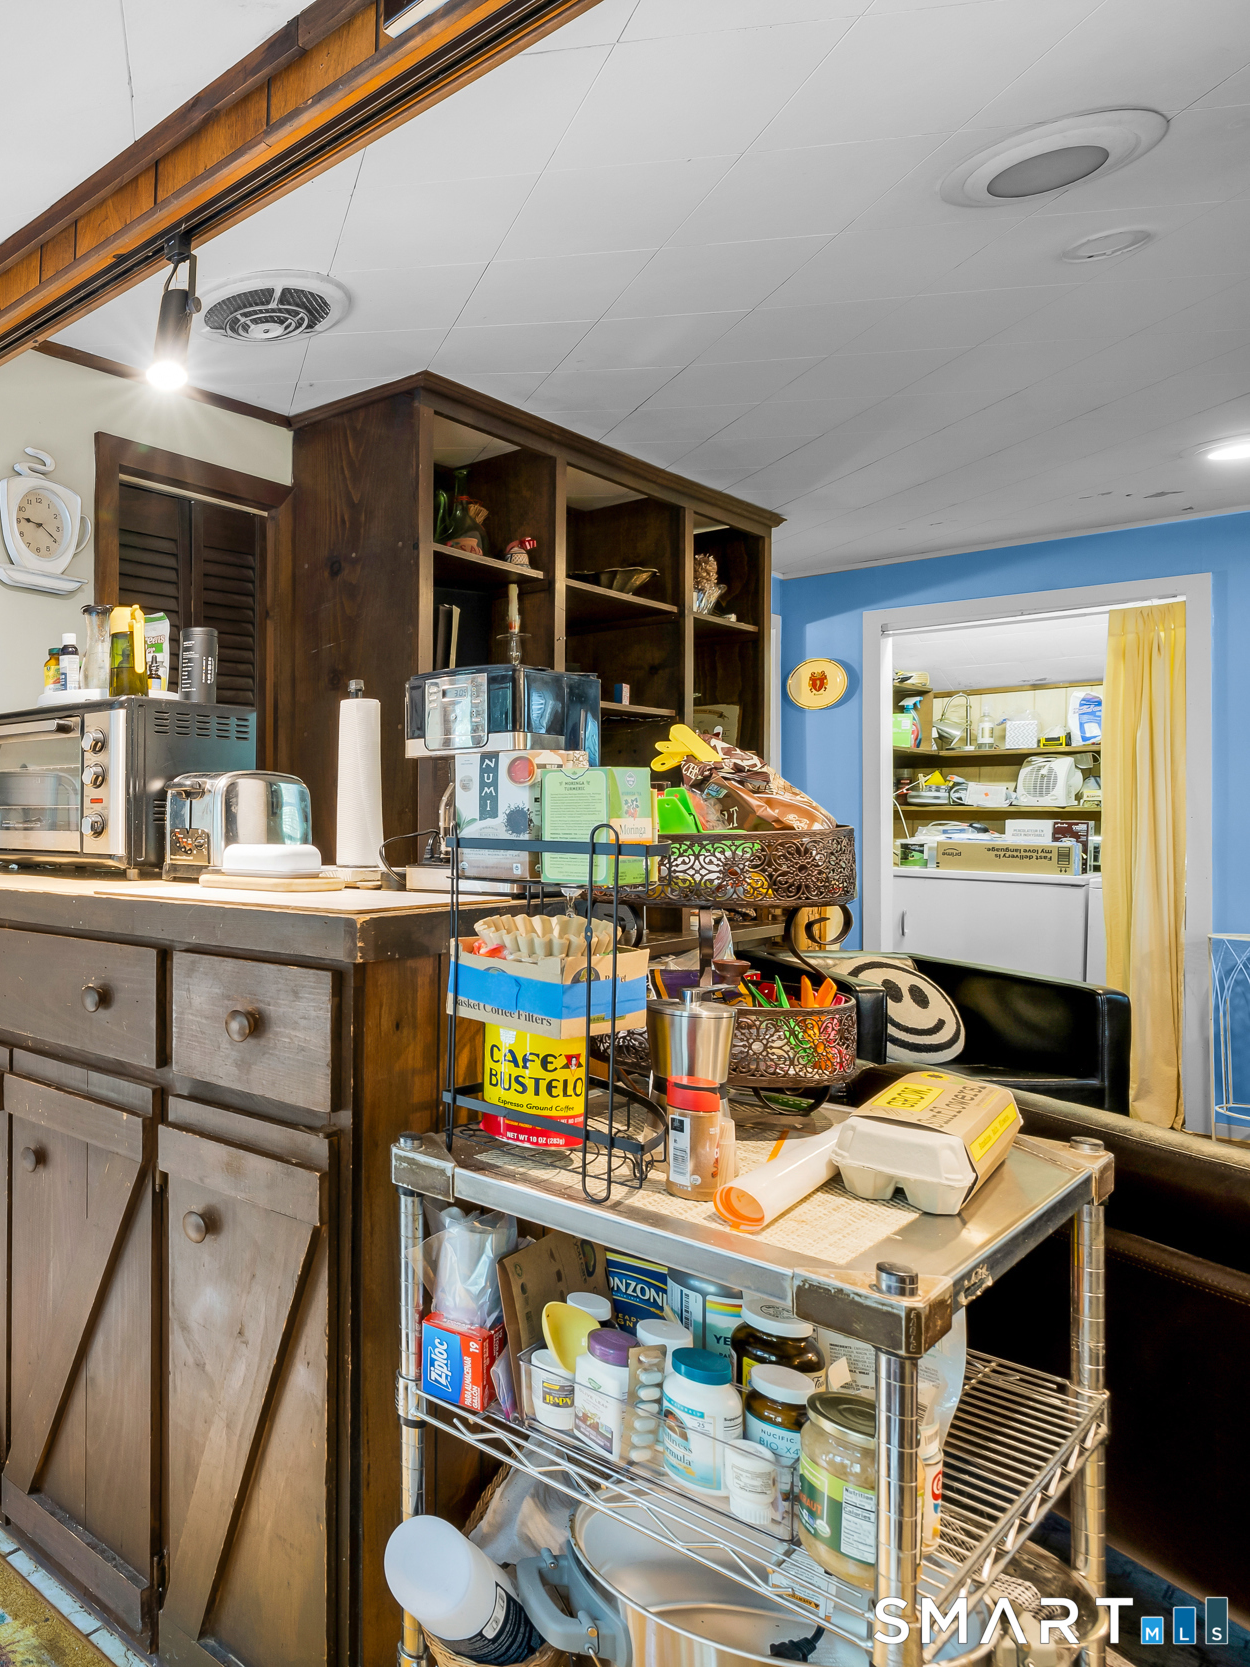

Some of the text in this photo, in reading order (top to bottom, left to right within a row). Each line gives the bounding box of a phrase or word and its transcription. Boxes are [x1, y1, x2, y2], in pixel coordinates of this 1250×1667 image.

[145, 634, 166, 645] reens
[481, 758, 496, 811] NUMI
[619, 824, 646, 837] Moringa
[984, 847, 1022, 855] language.
[1002, 853, 1034, 861] delivery
[1035, 854, 1053, 862] Fast
[453, 997, 481, 1011] asket
[516, 1009, 552, 1027] Filters
[489, 1043, 563, 1073] CAFÉ
[488, 1066, 584, 1099] BUSTELO
[497, 1096, 575, 1114] Espresso Ground Coffee
[506, 1131, 518, 1139] NET
[537, 1136, 547, 1144] OZ
[547, 1138, 566, 1146] (283g)
[469, 1341, 480, 1353] 19
[430, 1336, 452, 1386] Ziploc
[463, 1356, 472, 1407] PARA ALMACENAR
[544, 1394, 573, 1406] Advil
[578, 1387, 593, 1401] OLIVE
[594, 1398, 608, 1410] LEAF
[664, 1430, 693, 1454] ellness
[760, 1428, 795, 1444] NUCIFIC
[844, 1487, 873, 1502] Nutrition
[843, 1506, 871, 1521] Calories
